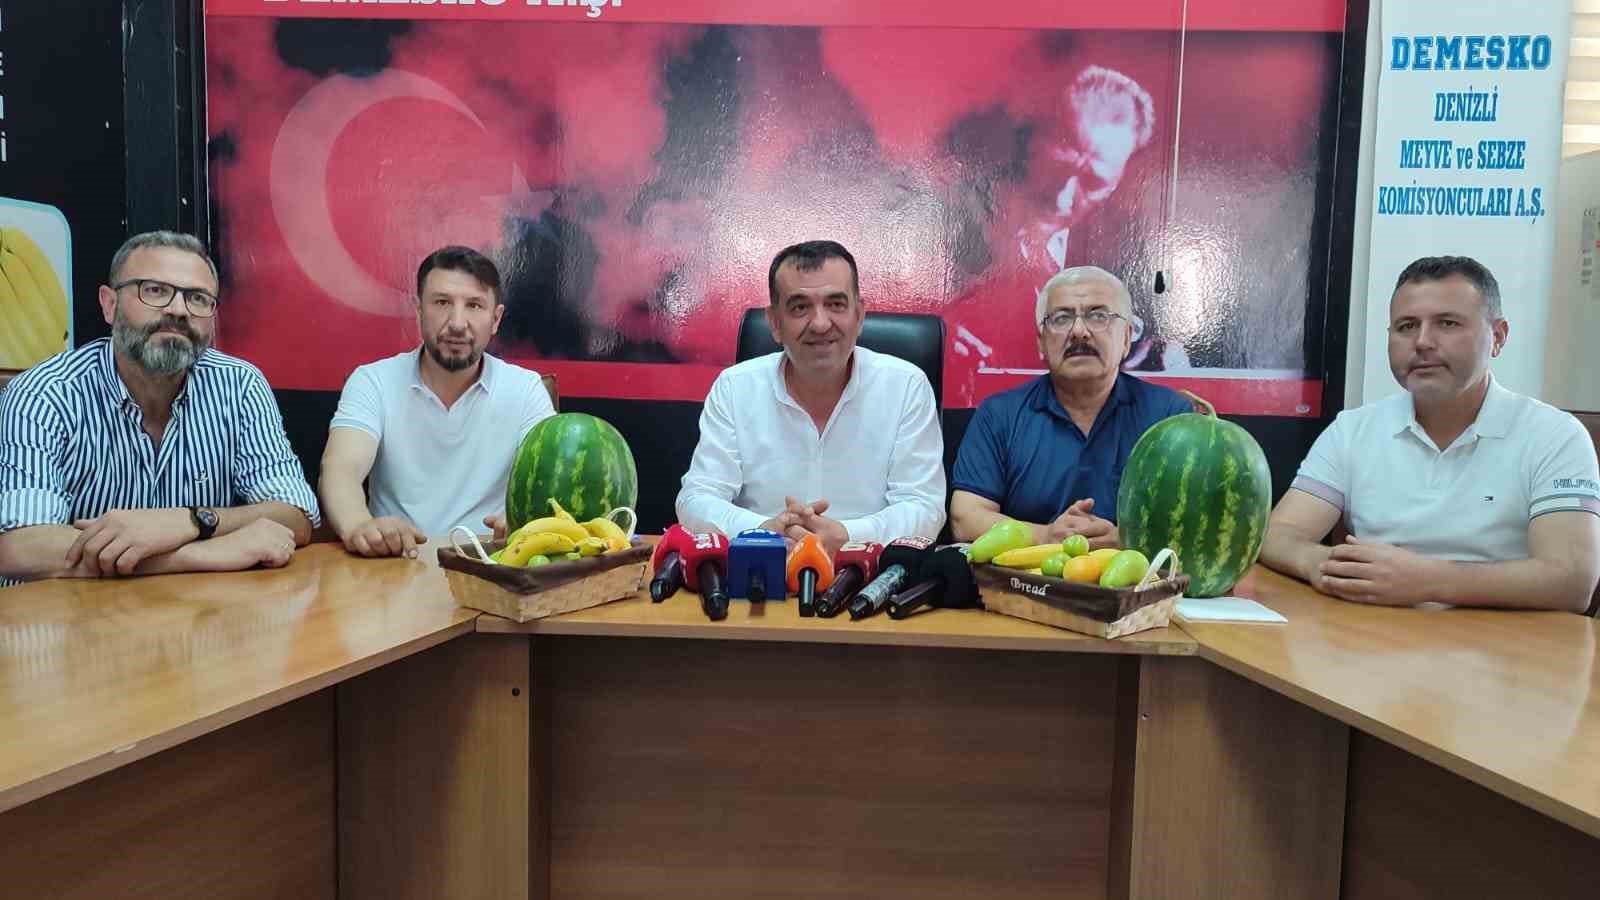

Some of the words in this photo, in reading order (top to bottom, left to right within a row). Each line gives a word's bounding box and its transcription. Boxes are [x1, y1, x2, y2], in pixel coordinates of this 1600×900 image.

[1391, 35, 1552, 71] DEMESKO
[1434, 85, 1498, 122] DENİZLİ
[1400, 140, 1452, 169] MEYVE
[1456, 147, 1473, 169] ve
[1477, 141, 1526, 170] SEBZE
[1378, 180, 1512, 216] KOMİSYONCULARI
[1515, 188, 1545, 224] A.Ş.
[1010, 577, 1050, 596] Bread
